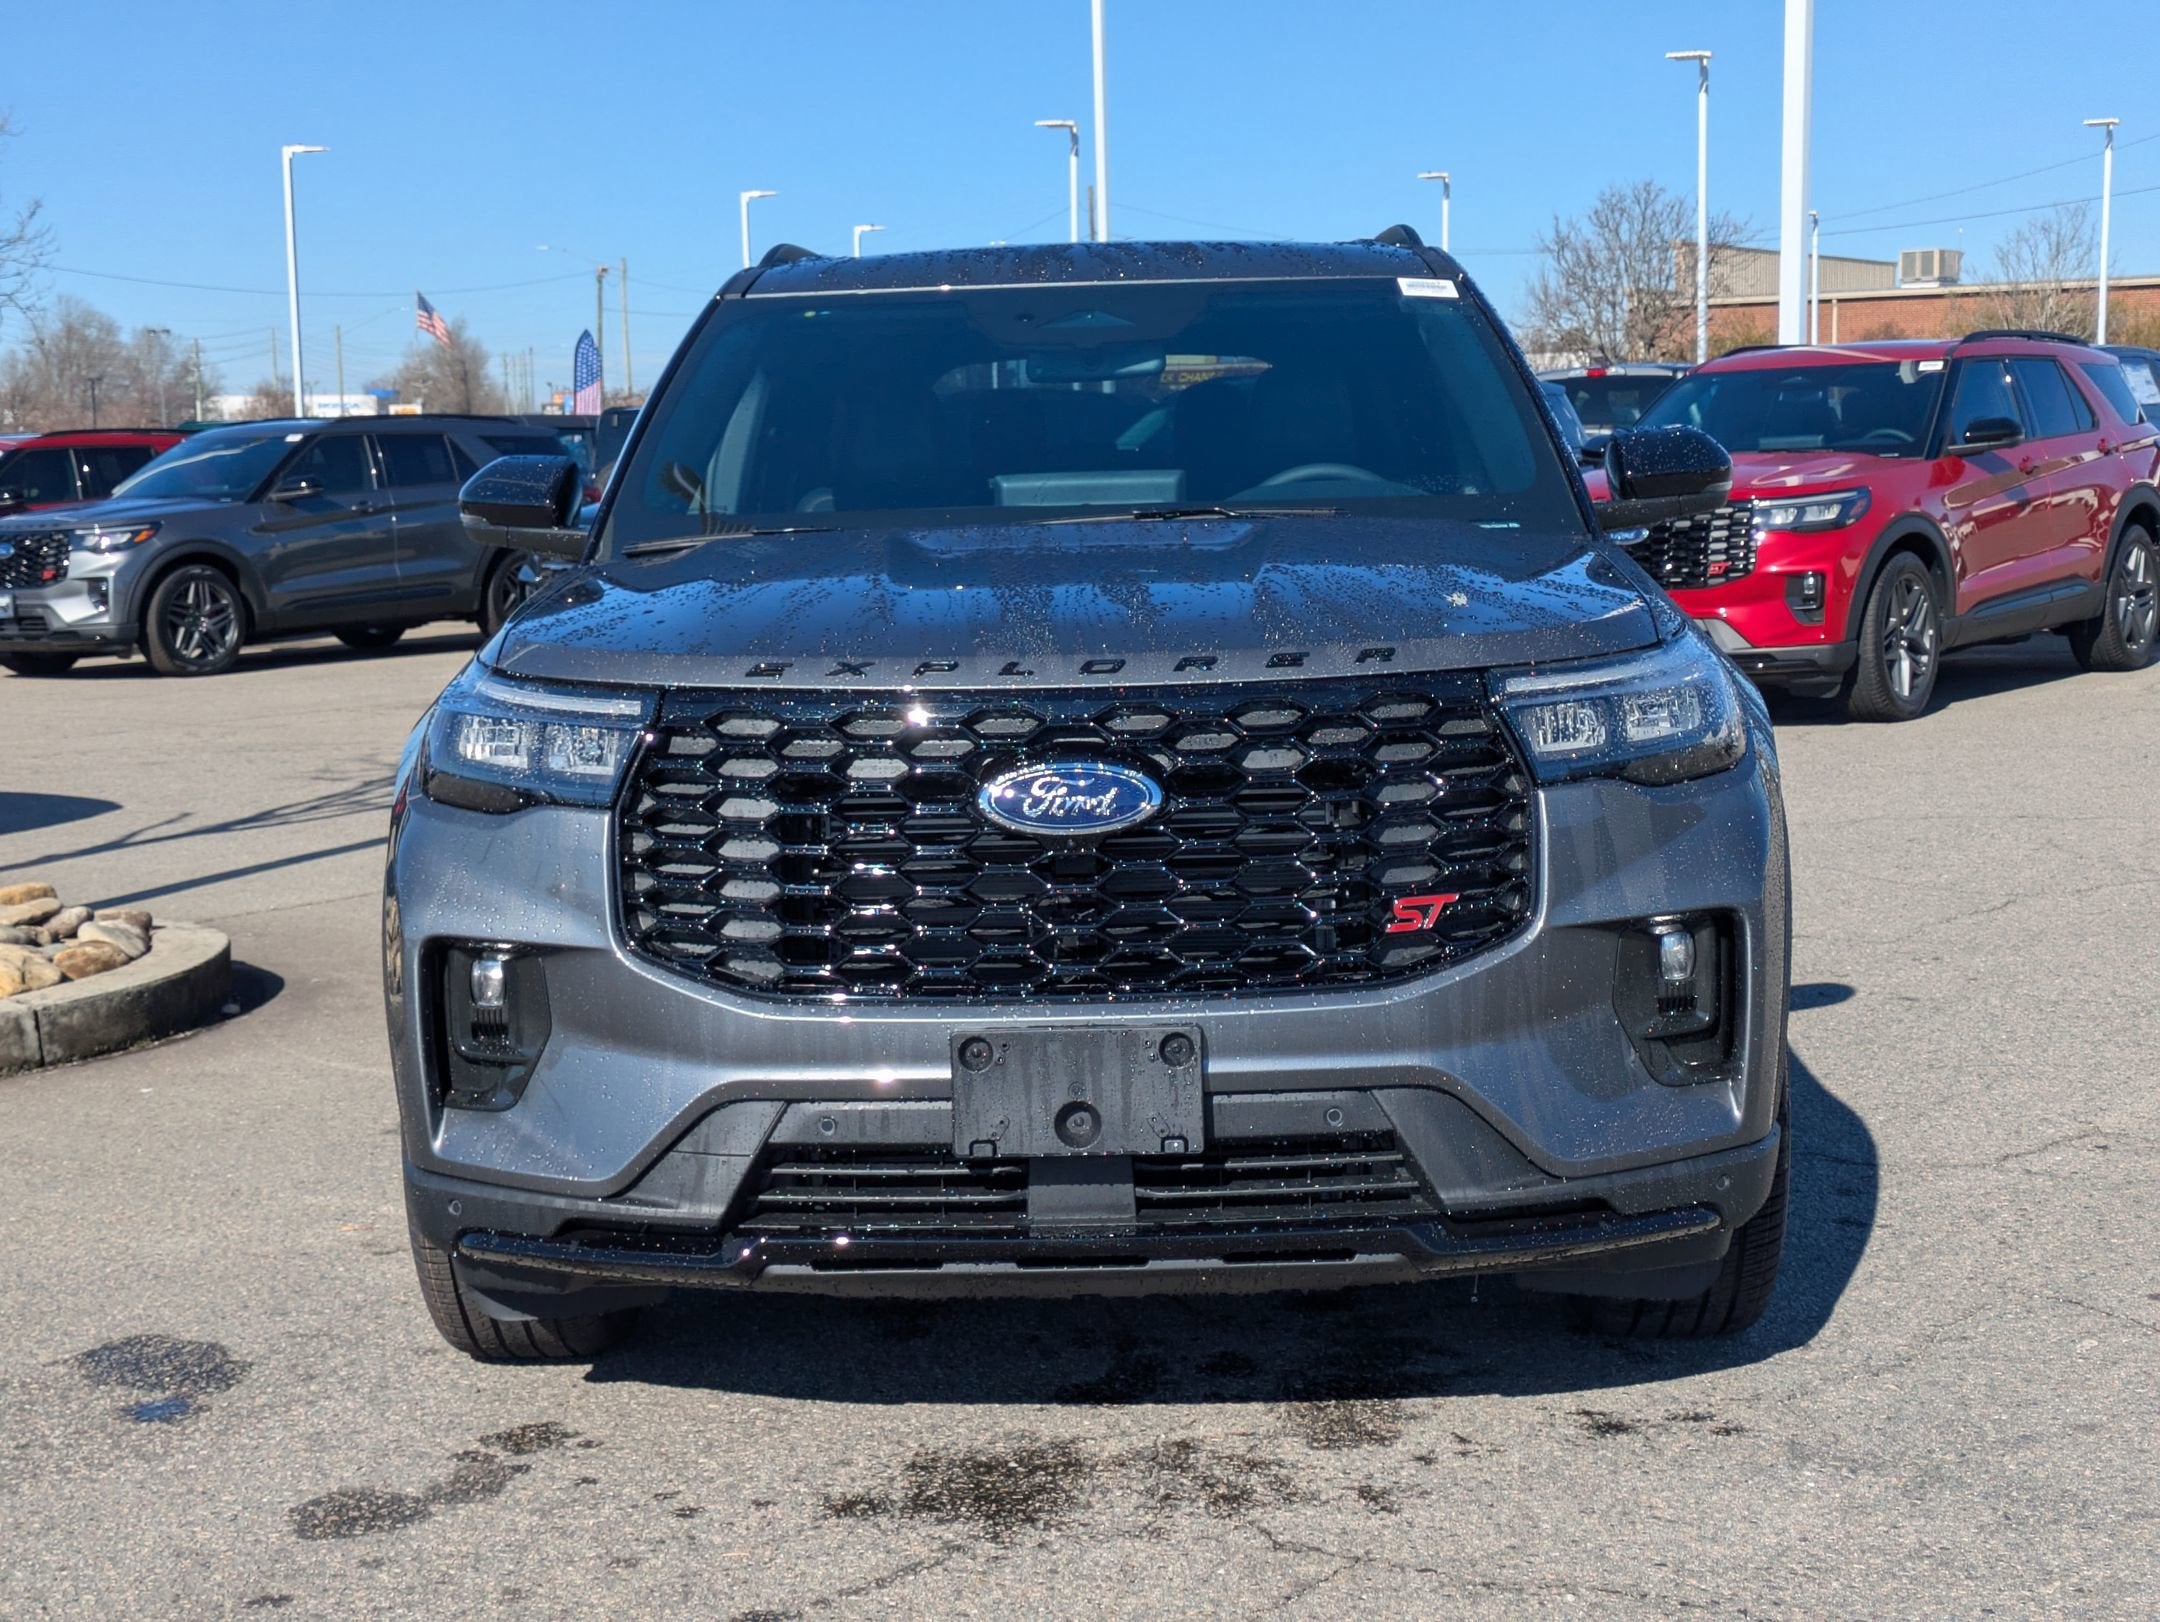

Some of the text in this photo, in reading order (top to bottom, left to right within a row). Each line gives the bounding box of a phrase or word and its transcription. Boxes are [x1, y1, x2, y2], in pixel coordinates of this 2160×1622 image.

[745, 647, 1396, 677] EXPLORER
[1022, 776, 1119, 818] Ford
[1385, 893, 1460, 933] ST
